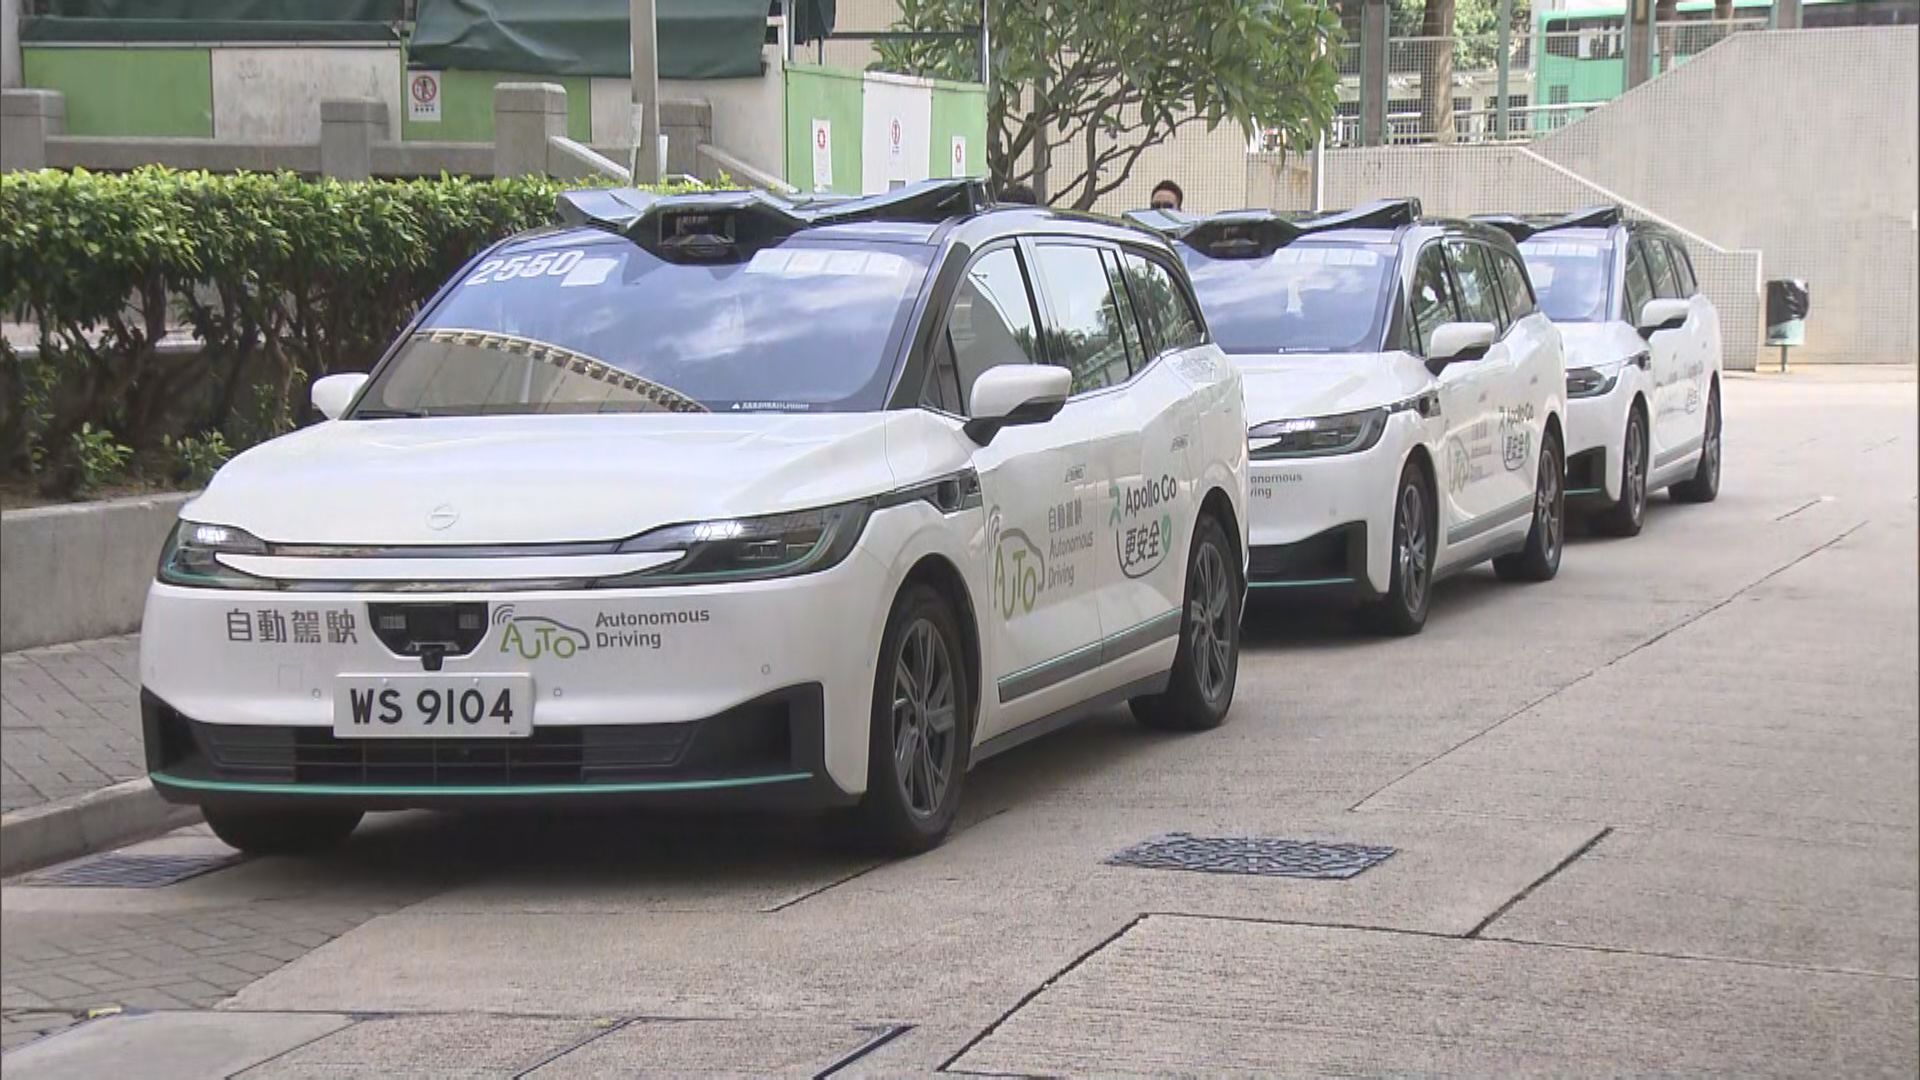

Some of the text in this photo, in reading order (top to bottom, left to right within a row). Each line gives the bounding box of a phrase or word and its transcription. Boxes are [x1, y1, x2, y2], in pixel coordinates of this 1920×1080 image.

[1250, 474, 1303, 484] onomous
[1125, 479, 1160, 518] Apollo
[1125, 520, 1160, 567] 更安全
[226, 607, 358, 644] 自動駕駛
[595, 609, 710, 628] Autonomous
[596, 630, 661, 649] Driving
[350, 688, 513, 725] WS 9104
